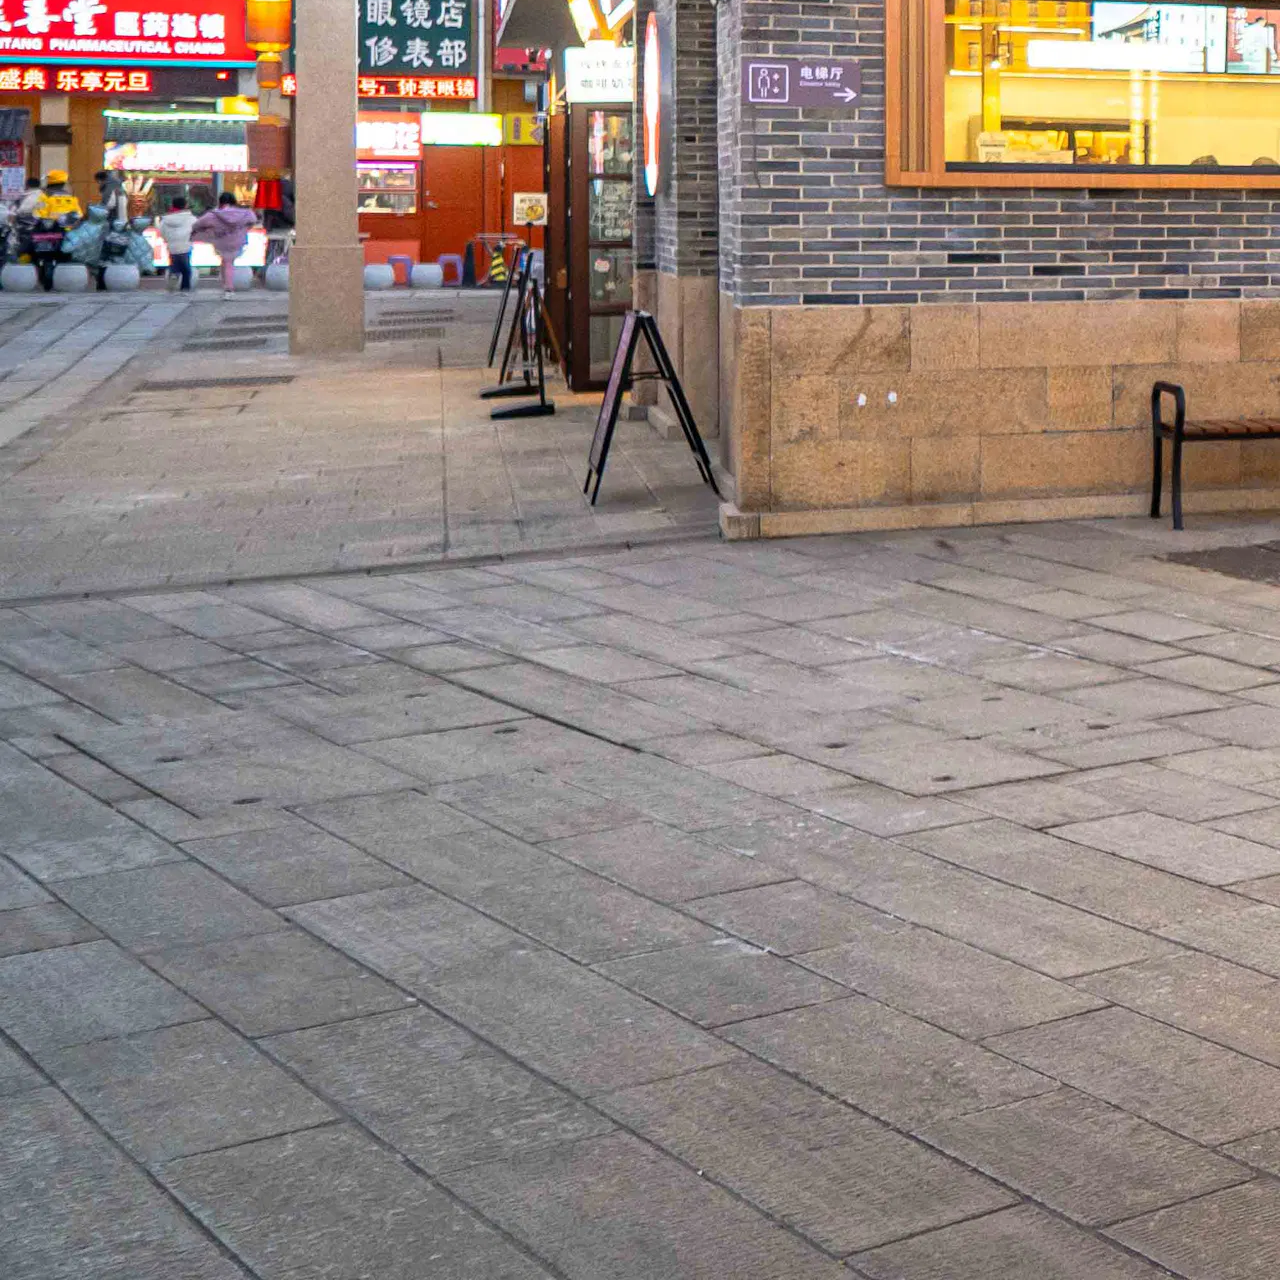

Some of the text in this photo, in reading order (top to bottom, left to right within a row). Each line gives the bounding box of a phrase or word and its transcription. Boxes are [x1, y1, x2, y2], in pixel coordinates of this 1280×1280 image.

[357, 35, 467, 69] 修表部
[56, 69, 150, 91] 乐享元旦
[800, 66, 843, 80] 电梯厅
[399, 78, 476, 97] 钟表眼镜
[580, 78, 633, 88] 咖啡奶
